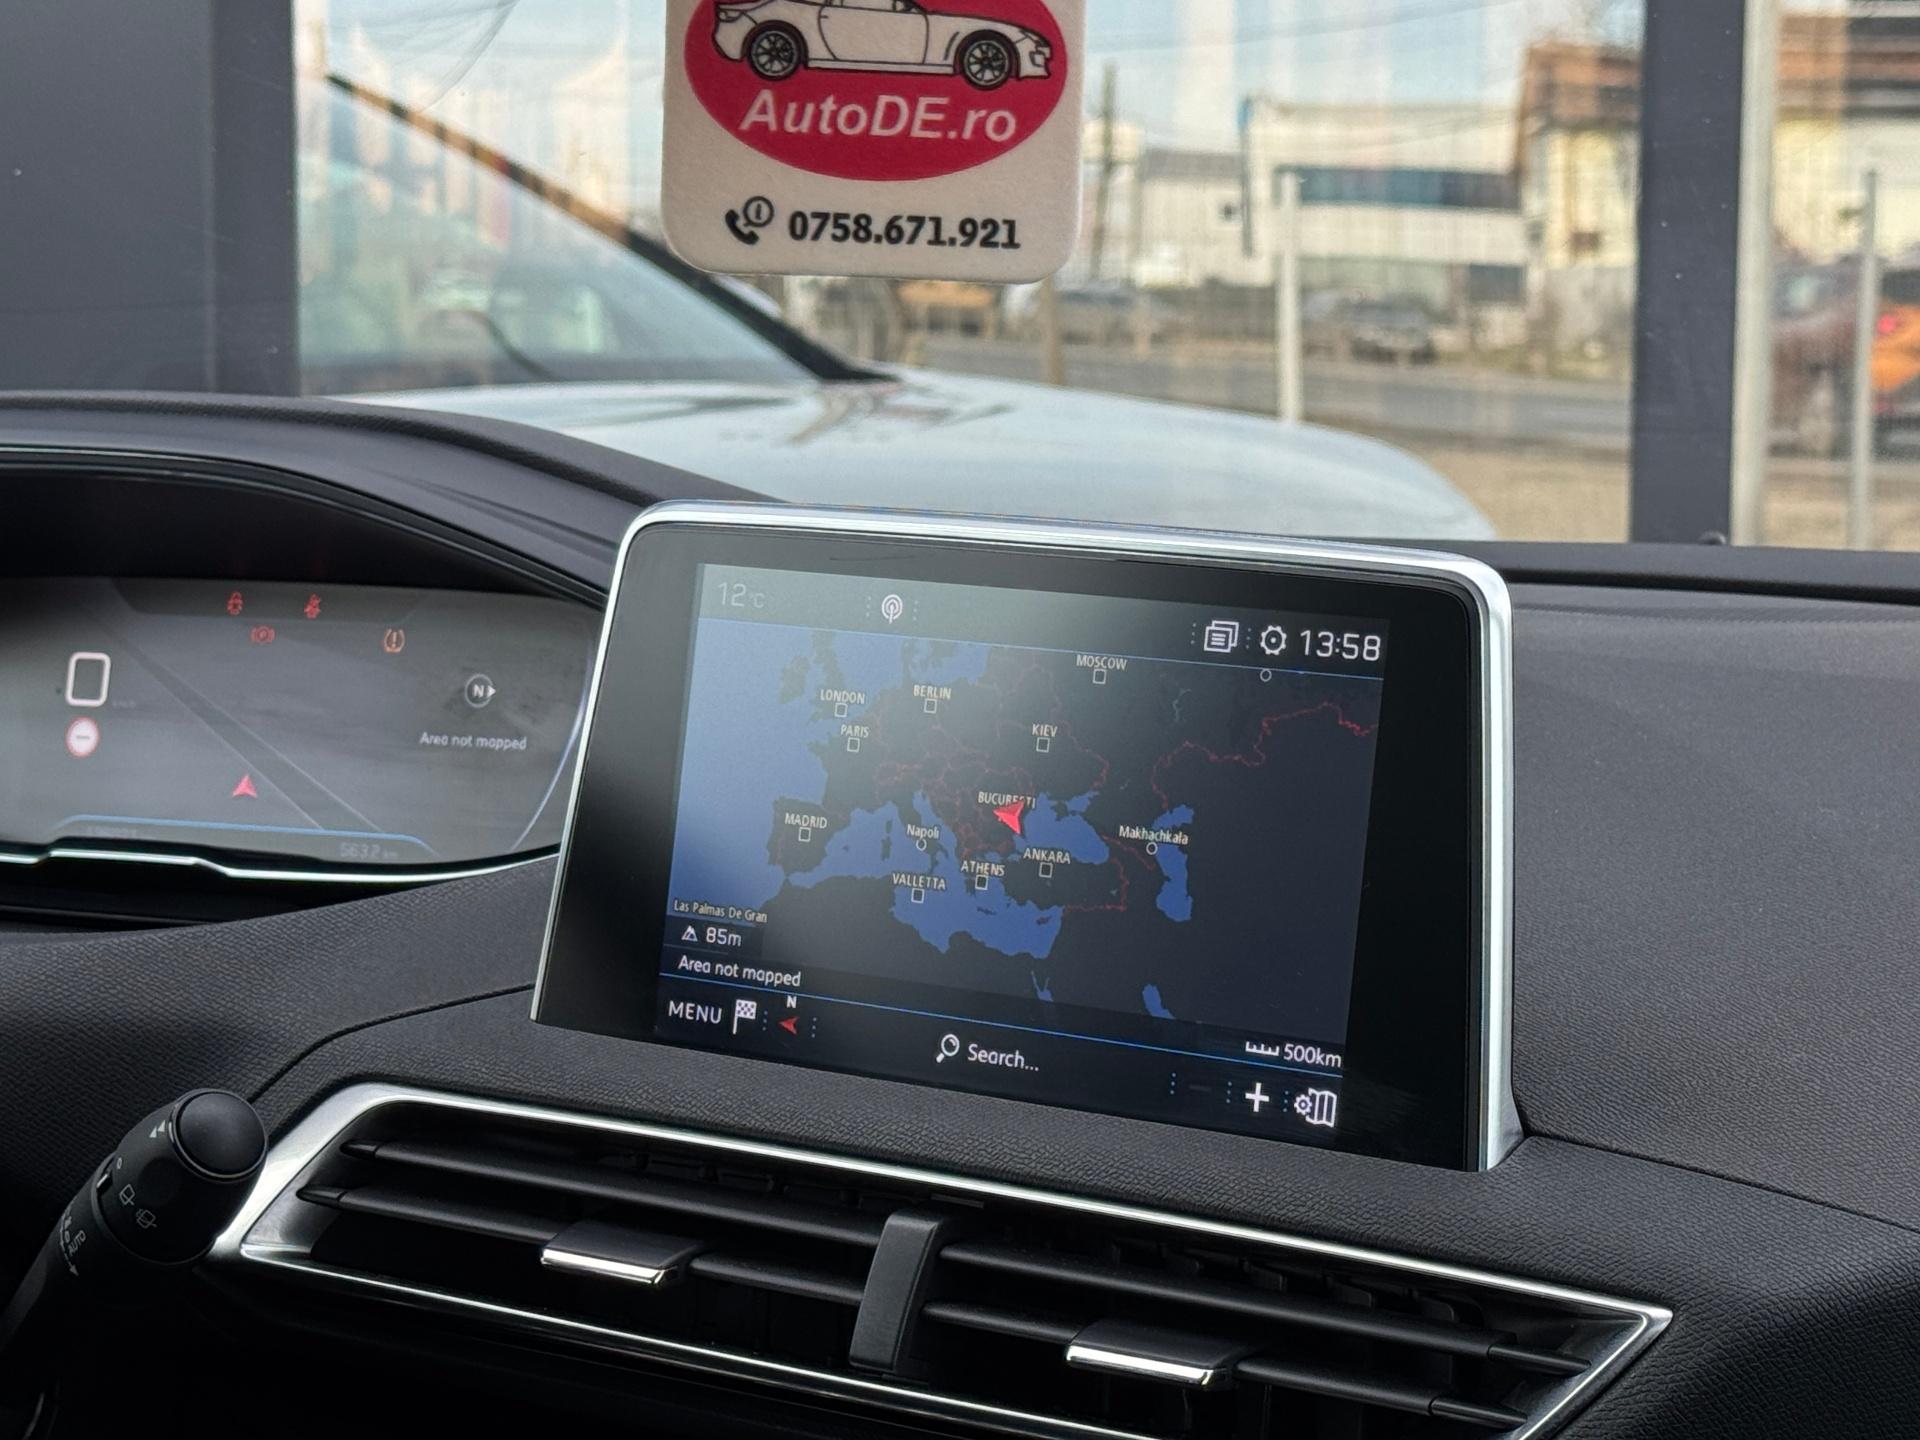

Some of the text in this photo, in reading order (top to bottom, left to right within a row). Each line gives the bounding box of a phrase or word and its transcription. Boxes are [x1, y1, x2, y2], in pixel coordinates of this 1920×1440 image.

[740, 88, 1016, 142] AutoDE.ro
[788, 211, 1021, 249] 0758.671.921
[1300, 629, 1381, 661] 13:58
[1076, 654, 1127, 671] MOSCOW
[820, 689, 865, 704] LONDON
[913, 684, 951, 700] BERLIN
[840, 724, 869, 738] PARIS
[1032, 724, 1058, 738] KIEV
[420, 732, 527, 751] Area not mapped
[784, 812, 827, 829] MADRID
[906, 824, 939, 841] Napoli
[1118, 825, 1189, 845] Makhachkala
[1023, 848, 1071, 864] ANKARA
[960, 860, 1006, 876] ATHENS
[891, 872, 946, 890] VALLETTA
[674, 899, 768, 923] Las Palmas De Gran
[706, 927, 742, 946] 85m
[678, 954, 801, 987] Area not mapped
[786, 995, 797, 1009] N
[668, 1000, 722, 1024] MENU
[1283, 1043, 1342, 1067] 500km
